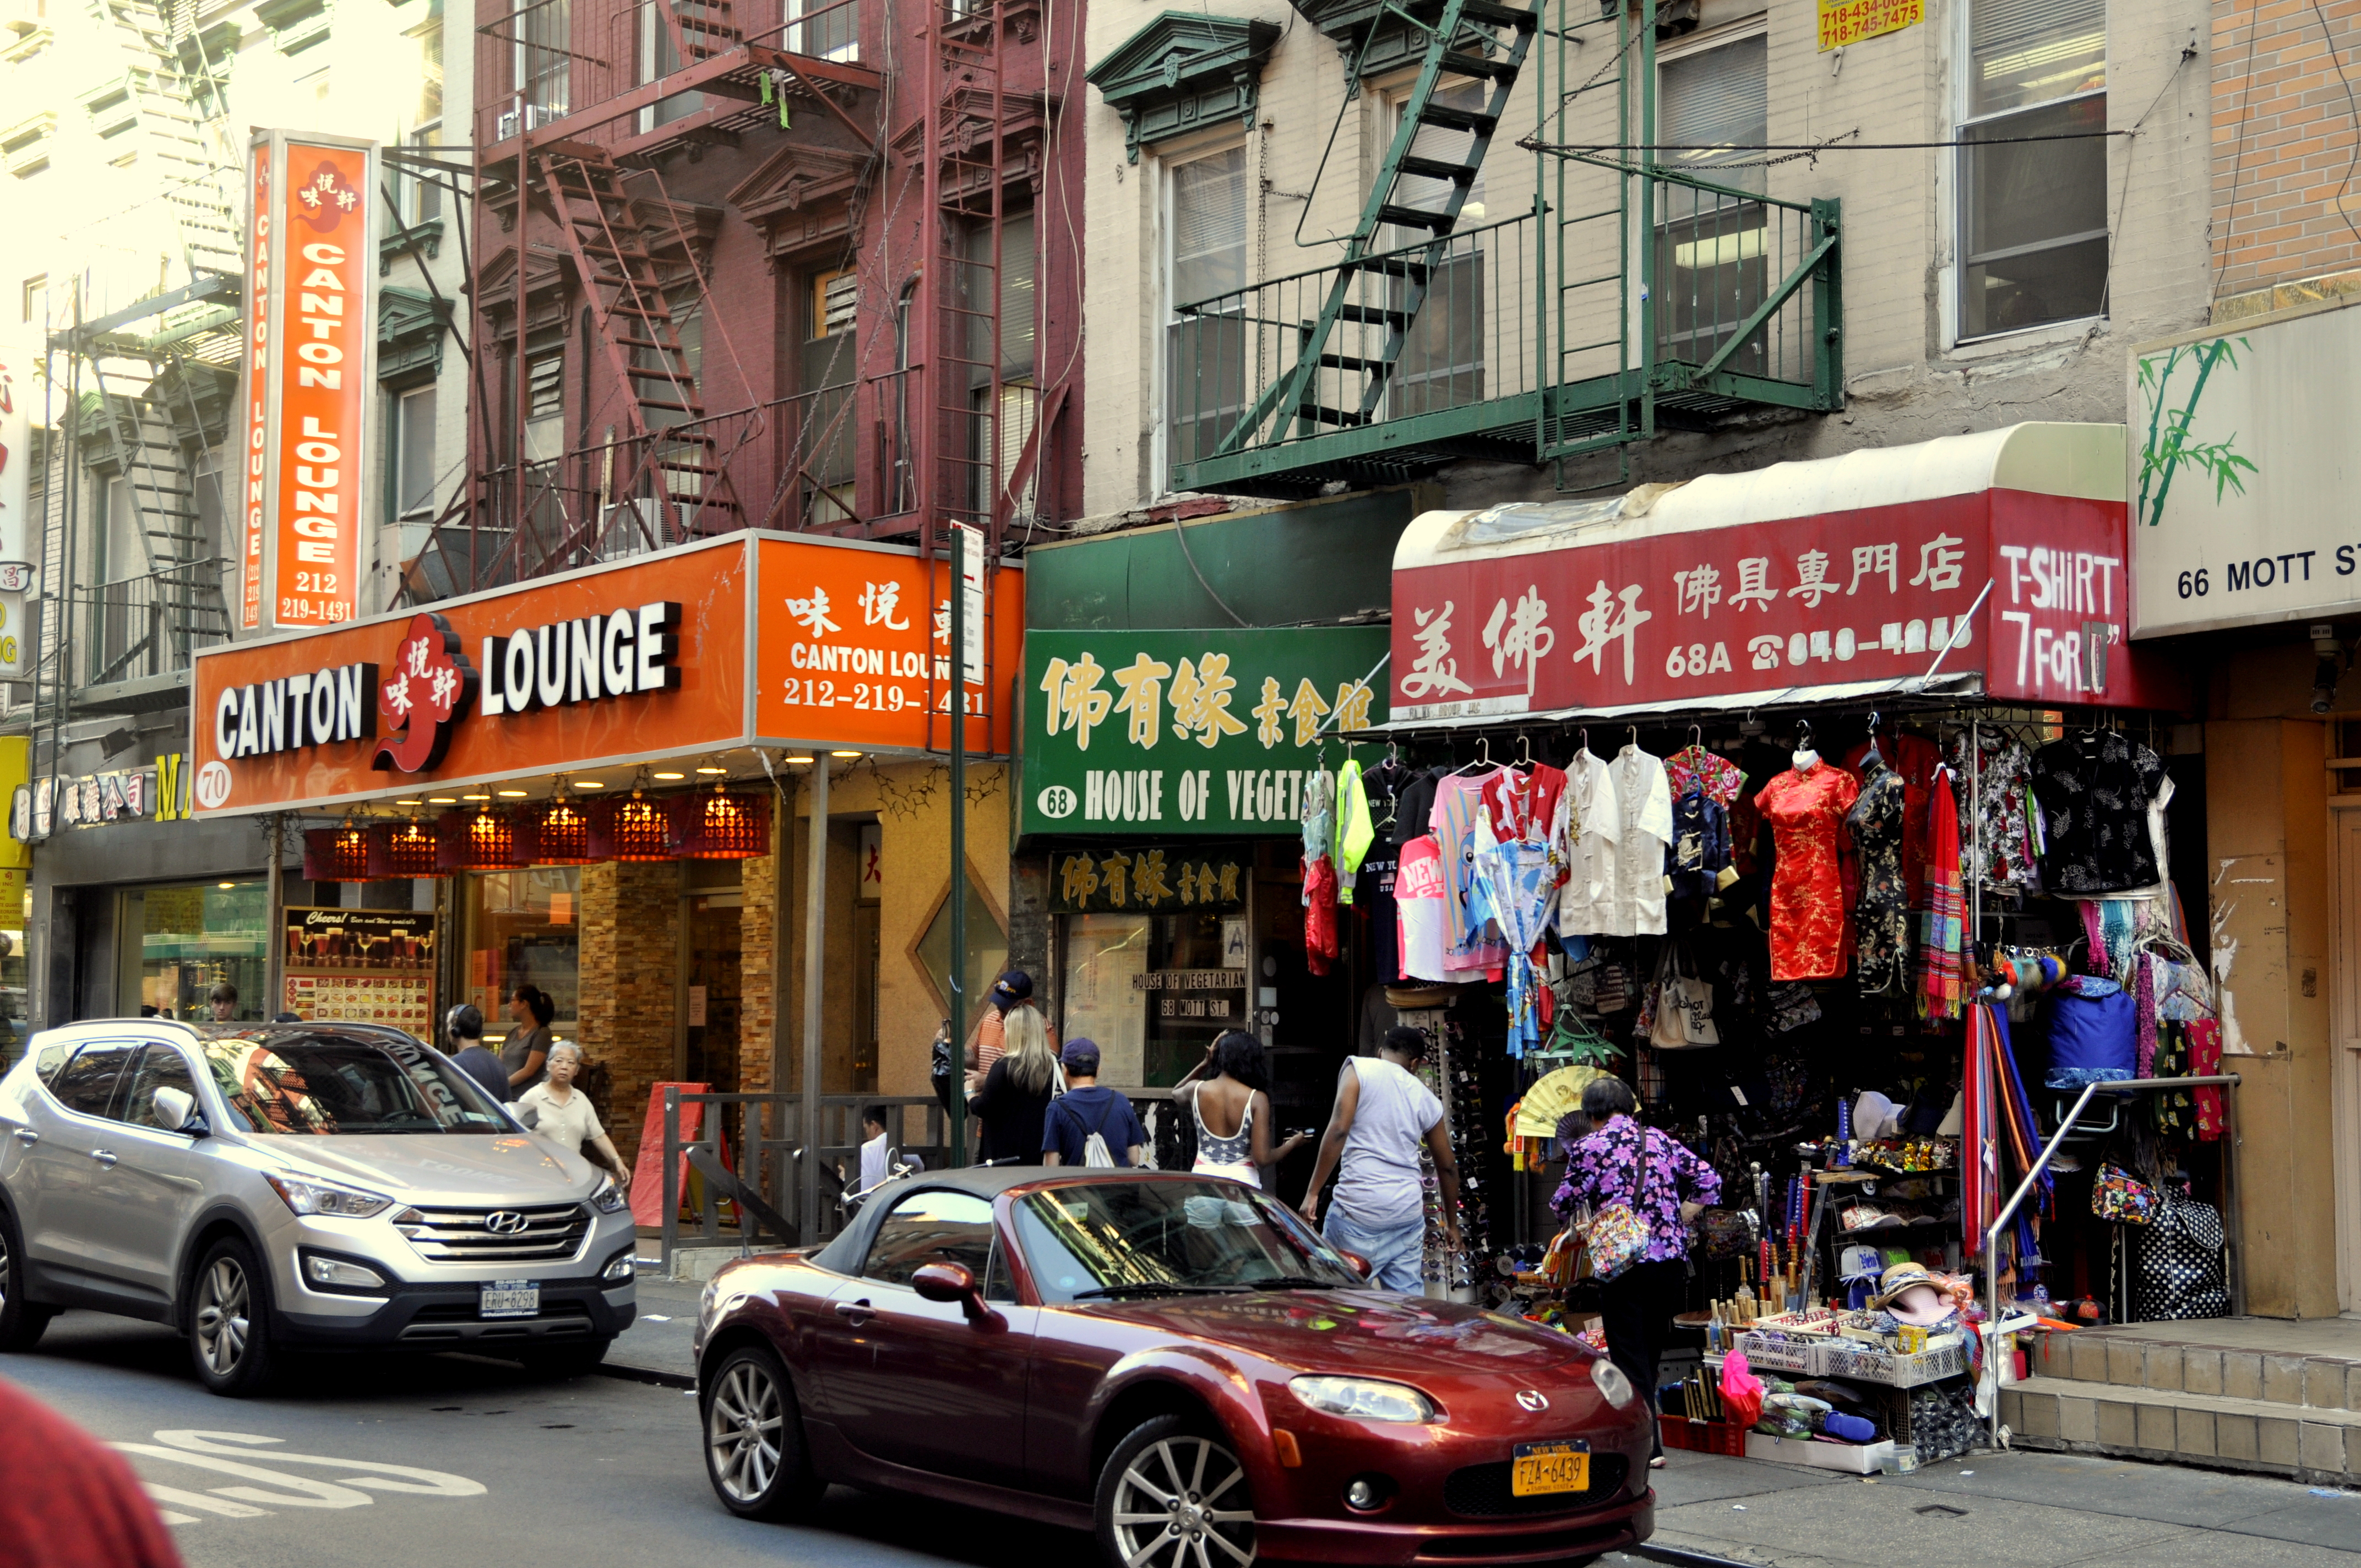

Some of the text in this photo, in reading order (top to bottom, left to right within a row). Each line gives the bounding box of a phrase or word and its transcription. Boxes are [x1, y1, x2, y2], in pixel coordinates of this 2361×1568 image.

[1823, 4, 1918, 46] 718-745-7475
[255, 215, 269, 370] CANTON
[298, 243, 346, 390] CANTON
[249, 401, 264, 556] LOUNGE
[296, 417, 341, 564] LOUNGE
[296, 572, 337, 594] 212
[1673, 532, 1965, 619] 佛具專門店
[2177, 568, 2209, 599] 66
[2227, 551, 2316, 592] MOTT
[282, 599, 351, 622] 219-1431
[1400, 580, 1652, 698] 美佛軒
[2002, 611, 2030, 686] 7
[481, 601, 665, 717] LOUNGE
[791, 643, 884, 676] CANTON
[1666, 641, 1732, 679] 68A
[216, 663, 361, 760] CANTON
[202, 770, 229, 798] 70
[1047, 788, 1068, 815] 68
[1084, 770, 1163, 821] HOUSE
[1178, 770, 1211, 822] OF
[1364, 861, 1385, 873] NEW
[1400, 855, 1444, 893] NEW
[306, 911, 349, 925] Cheers!
[1228, 926, 1244, 955] A
[1132, 972, 1246, 989] HOUSE OF VEGETARIAN
[1162, 1000, 1174, 1016] 68
[1180, 1000, 1205, 1016] MOTT
[510, 1291, 535, 1308] 8298
[1520, 1456, 1581, 1486] FZA 6439
